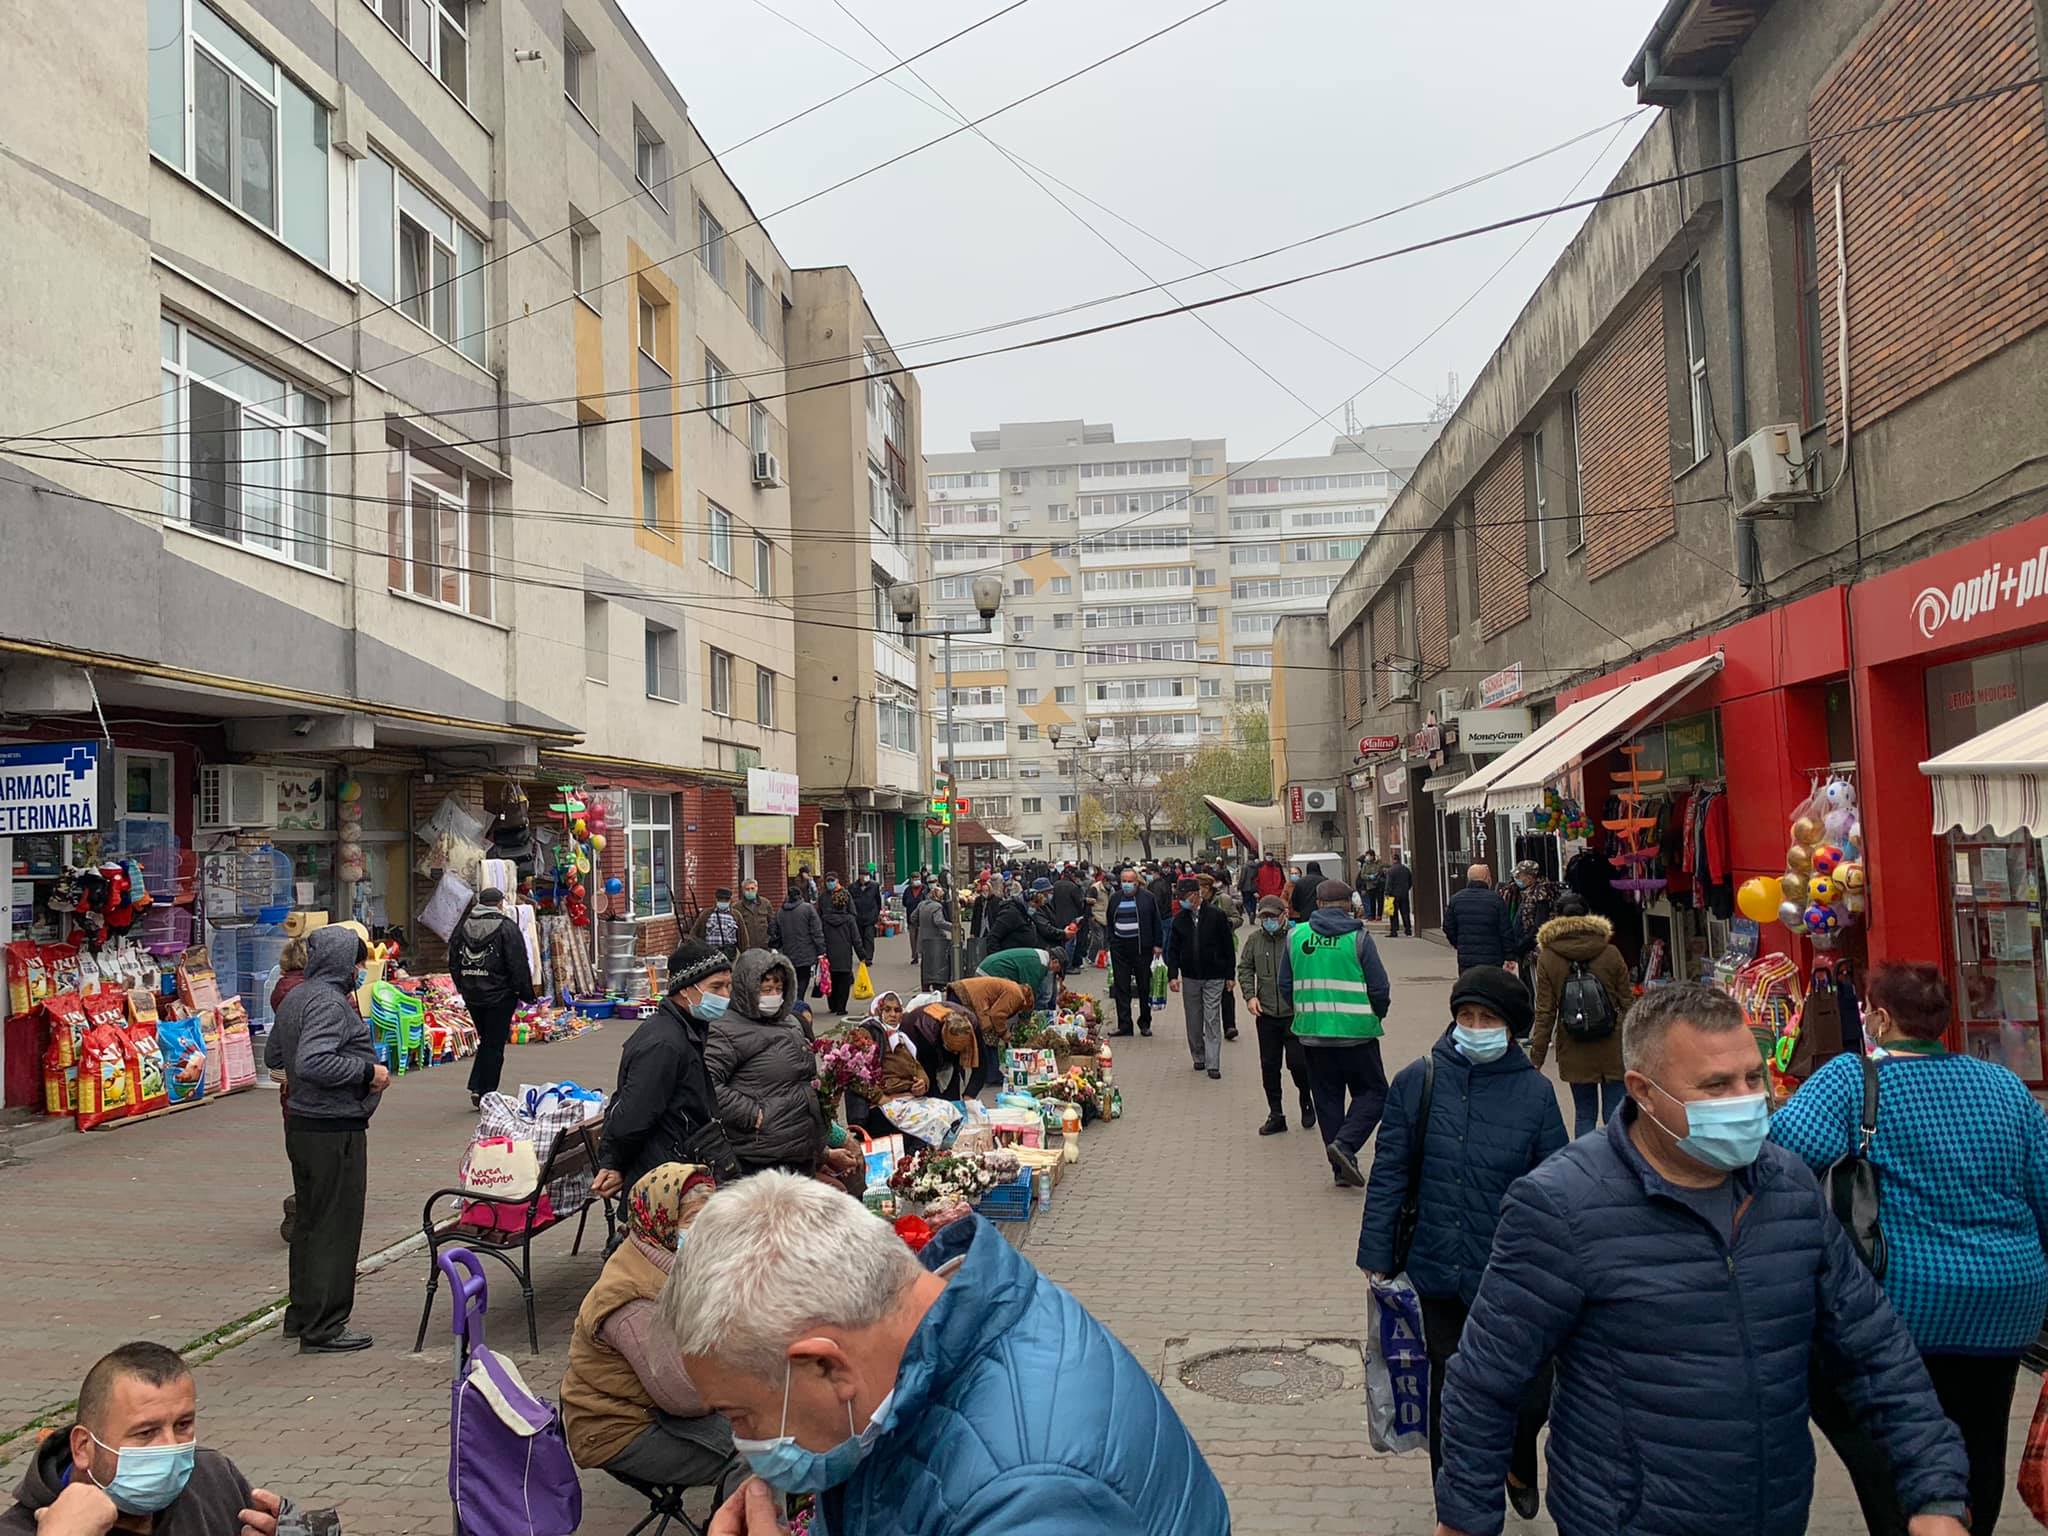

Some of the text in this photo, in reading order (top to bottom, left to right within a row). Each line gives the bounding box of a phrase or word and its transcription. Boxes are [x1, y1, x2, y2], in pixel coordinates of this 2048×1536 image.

[1951, 545, 2048, 622] opti+pl
[1468, 731, 1523, 741] MoneyGram
[1363, 738, 1394, 749] Malina
[471, 1174, 514, 1188] magenta
